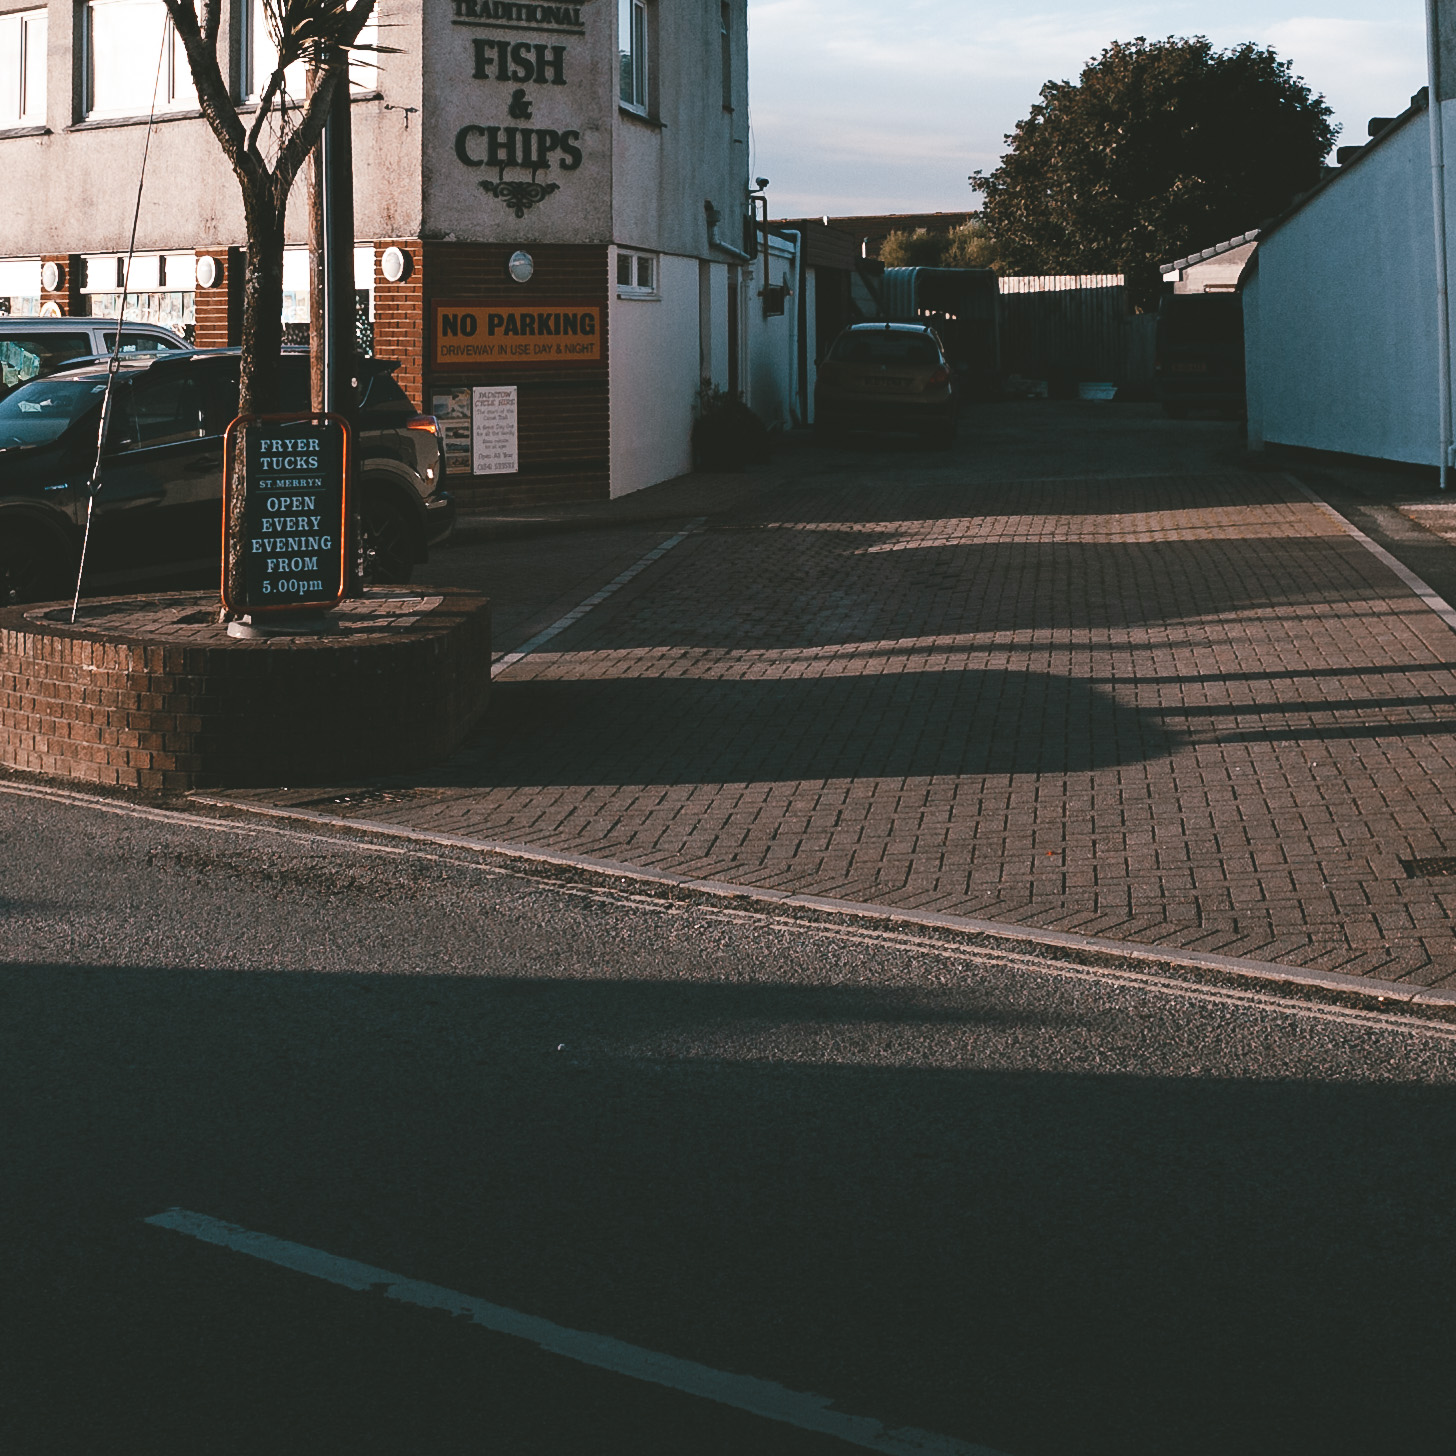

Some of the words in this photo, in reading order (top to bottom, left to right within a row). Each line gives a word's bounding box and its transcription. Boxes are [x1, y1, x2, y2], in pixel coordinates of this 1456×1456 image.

[472, 38, 567, 85] FISH
[509, 89, 533, 119] &
[454, 124, 583, 172] CHIPS
[442, 313, 478, 337] NO
[487, 312, 596, 337] PARKING
[440, 344, 495, 357] DRIVEWAY
[497, 344, 508, 356] IN
[510, 343, 531, 355] USE
[534, 343, 554, 355] DAY
[555, 343, 563, 355] &
[564, 342, 596, 355] NIGHT
[260, 439, 320, 452] FRYER
[260, 456, 318, 470] TUCKS
[267, 496, 316, 512] OPEN
[262, 516, 322, 532] EVERY
[251, 535, 332, 552] EVENING
[267, 557, 318, 572] FROM
[262, 579, 323, 595] 5.00pm
